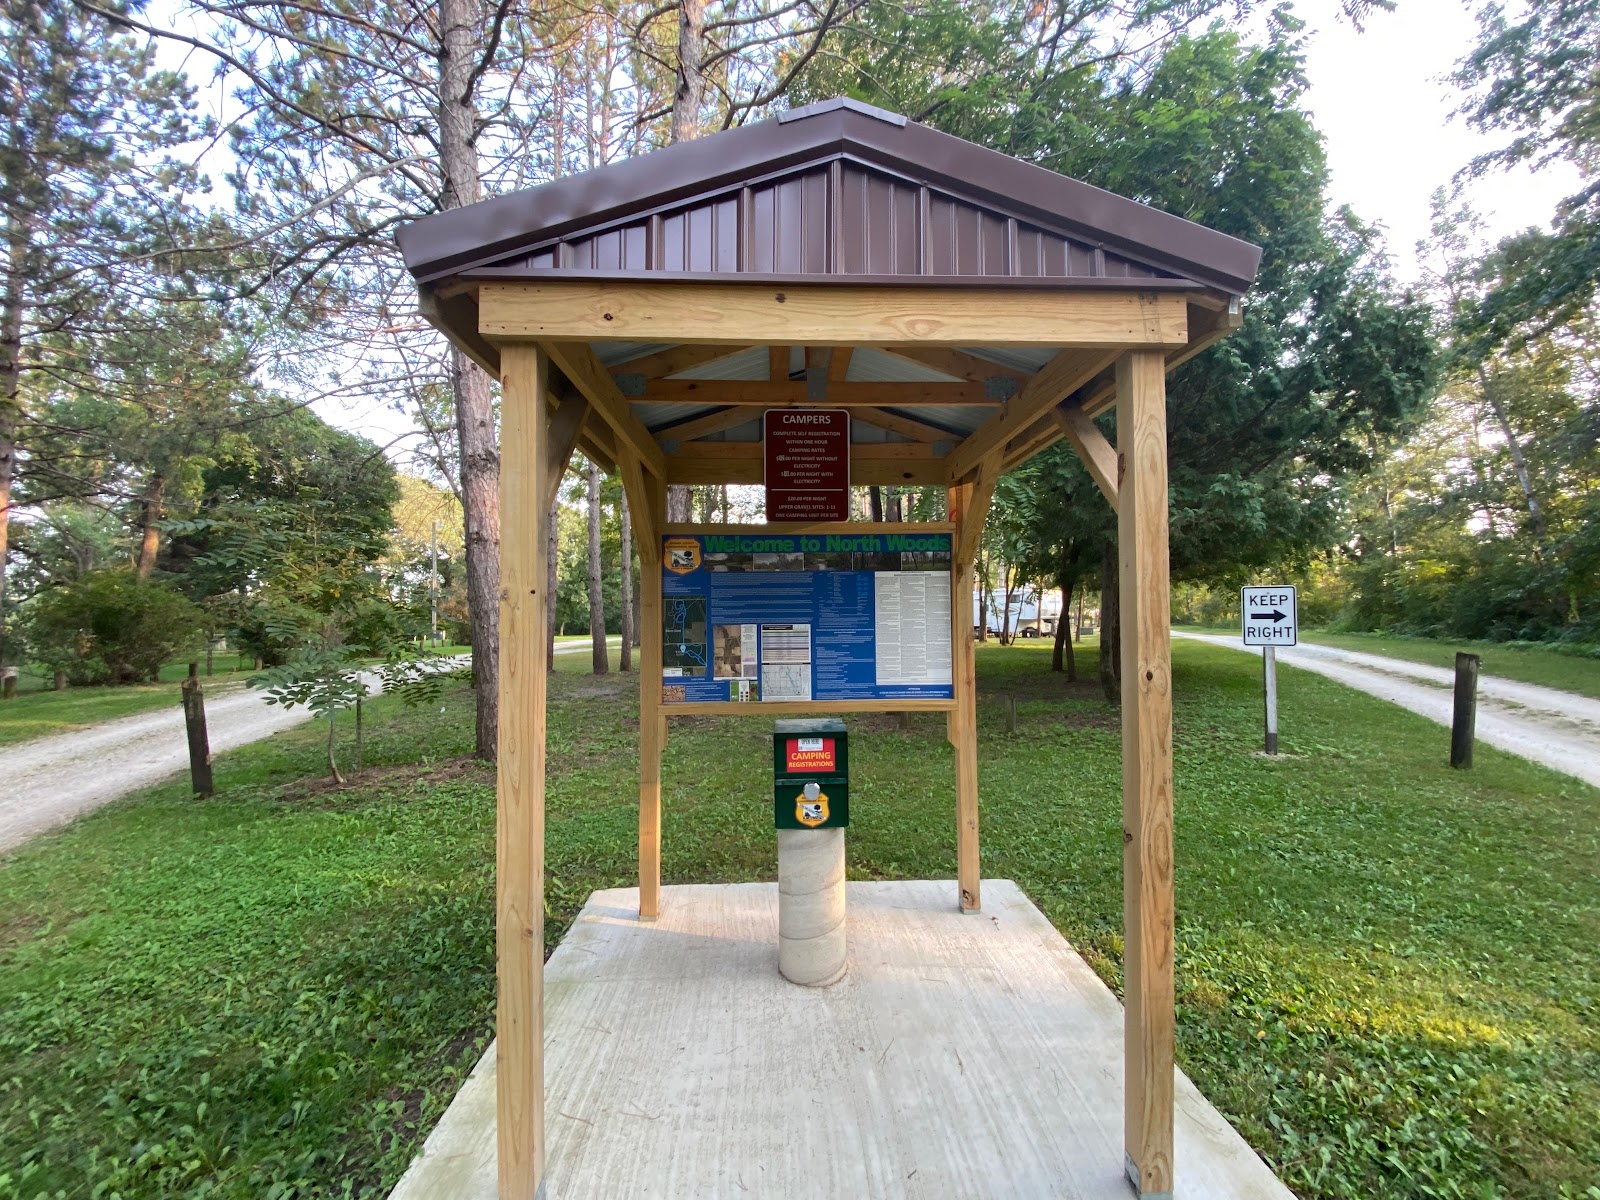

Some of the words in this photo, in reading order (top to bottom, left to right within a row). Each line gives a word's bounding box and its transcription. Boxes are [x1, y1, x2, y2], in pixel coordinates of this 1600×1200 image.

[782, 414, 831, 424] CAMPERS
[704, 535, 795, 552] Welcome
[801, 535, 820, 552] to
[826, 534, 880, 552] North
[885, 534, 950, 552] Woods
[1249, 594, 1288, 606] KEEP
[1247, 626, 1292, 638] RIGHT
[791, 752, 830, 760] CAMPING
